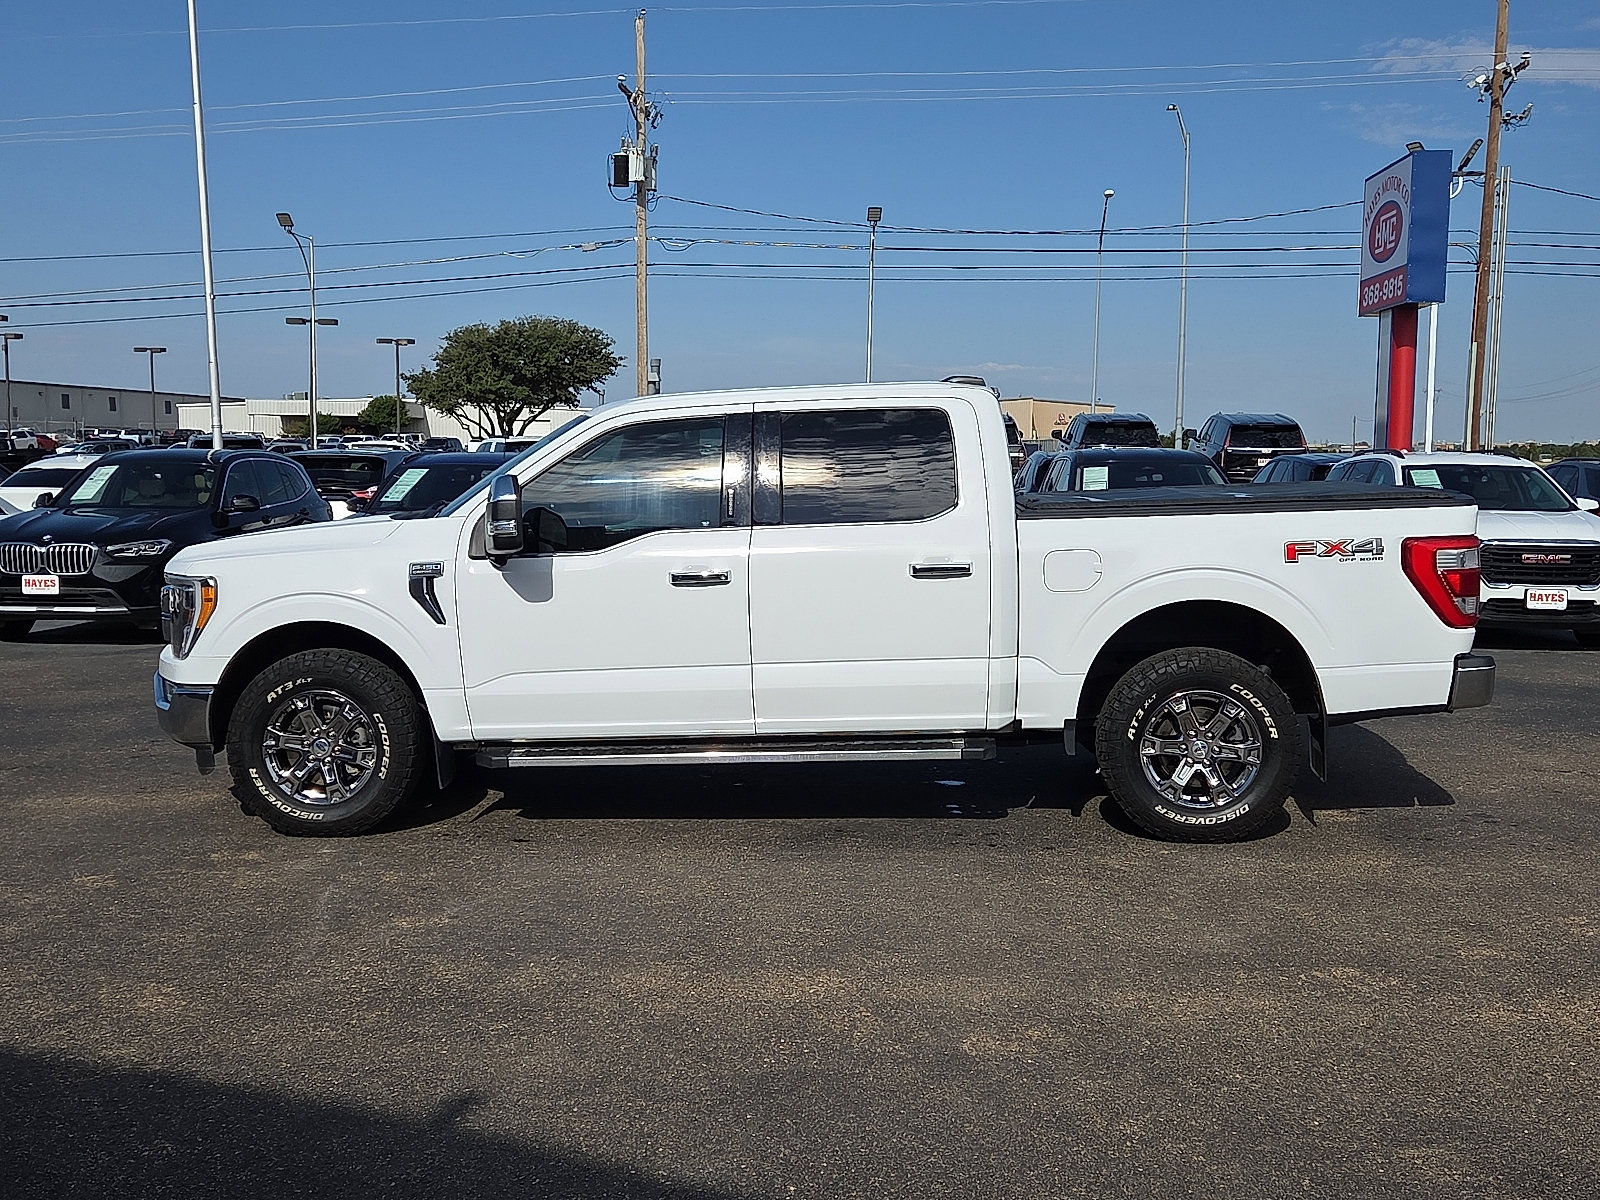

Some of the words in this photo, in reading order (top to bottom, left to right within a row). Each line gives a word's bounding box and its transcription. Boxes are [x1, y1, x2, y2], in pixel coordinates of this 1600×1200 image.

[1382, 176, 1401, 195] MOTOR
[1375, 210, 1397, 254] HMC
[1284, 537, 1384, 563] FX4
[1521, 553, 1572, 564] GMC
[24, 579, 56, 588] HAYES
[1529, 592, 1565, 603] HAYES
[267, 681, 293, 703] AT3
[295, 677, 313, 686] XLT
[1127, 708, 1145, 741] AT3
[1229, 683, 1279, 740] COOPER
[373, 713, 390, 780] COOPER
[248, 767, 325, 821] DISCOVERER
[1154, 803, 1250, 826] DISCOVERER
